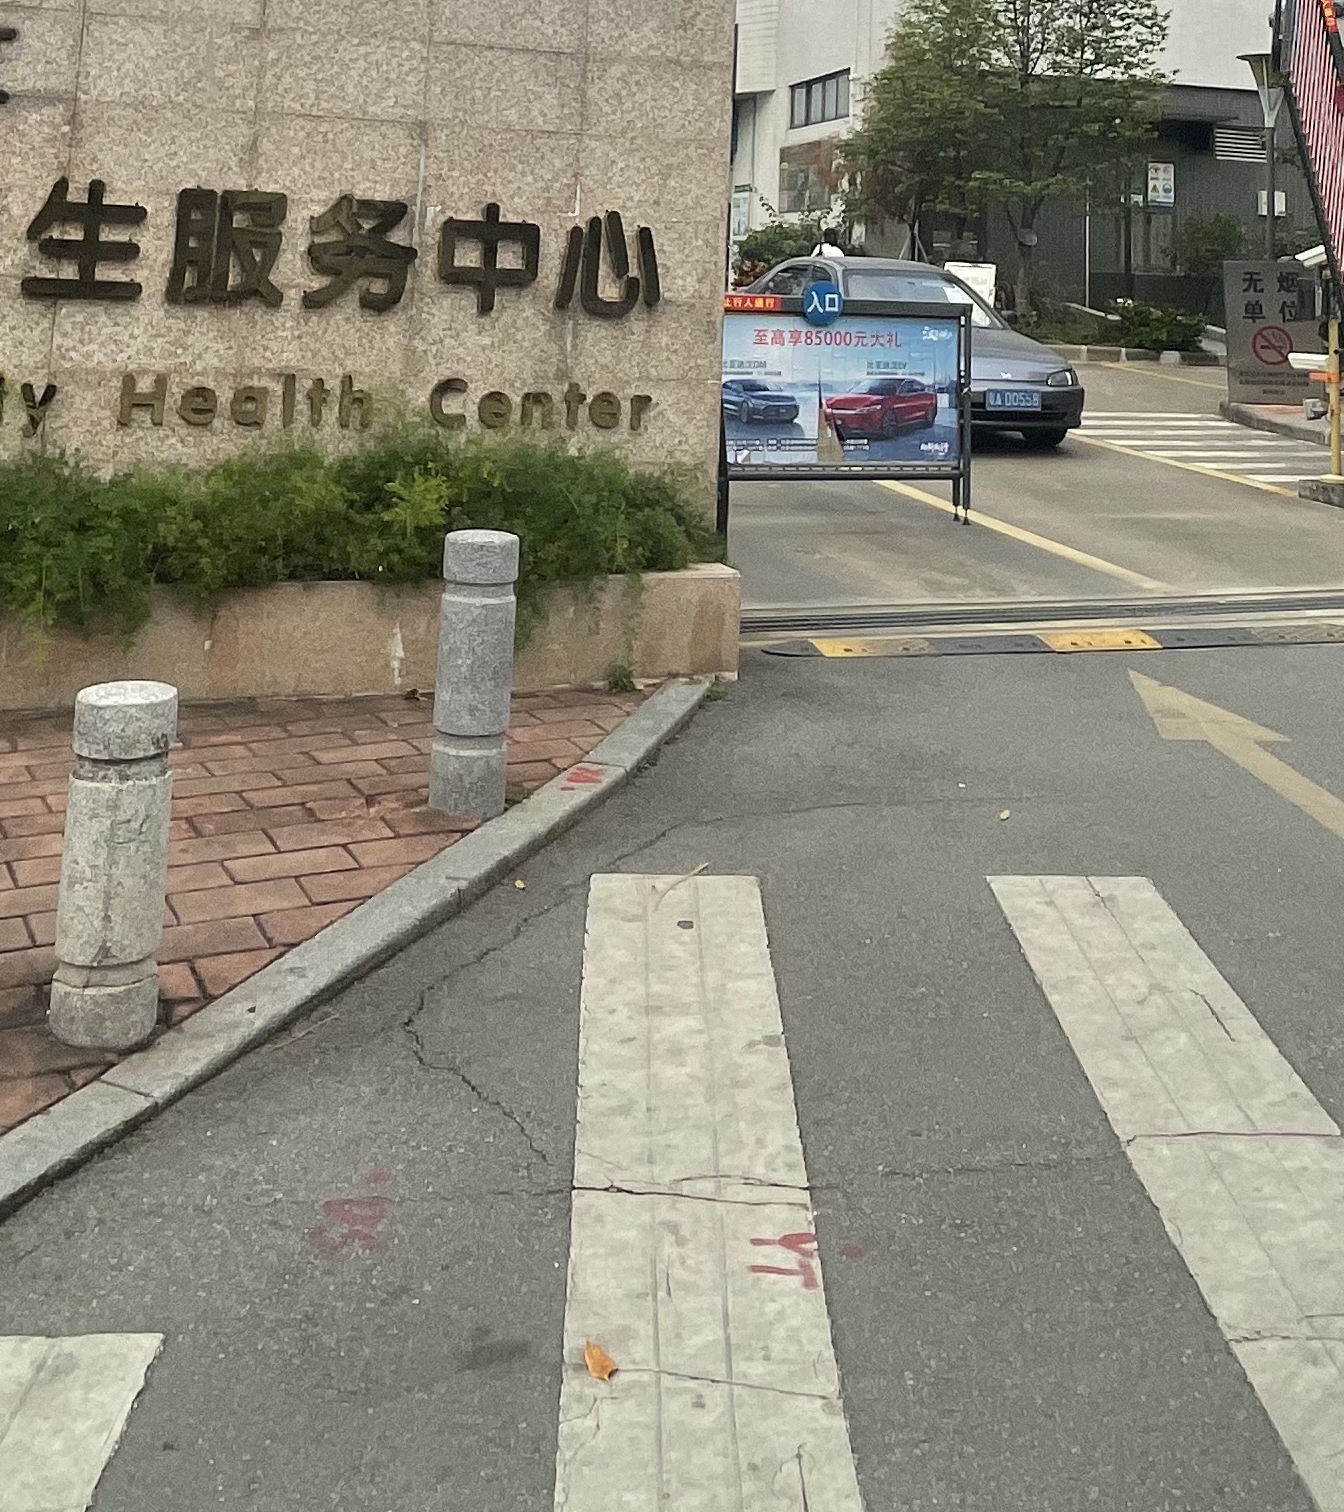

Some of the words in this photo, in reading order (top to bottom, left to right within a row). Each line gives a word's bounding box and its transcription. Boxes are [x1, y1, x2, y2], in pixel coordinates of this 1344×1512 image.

[807, 292, 839, 314] 入口
[752, 328, 902, 349] 至高享85000元大礼
[117, 372, 372, 431] Health
[429, 376, 656, 432] Center
